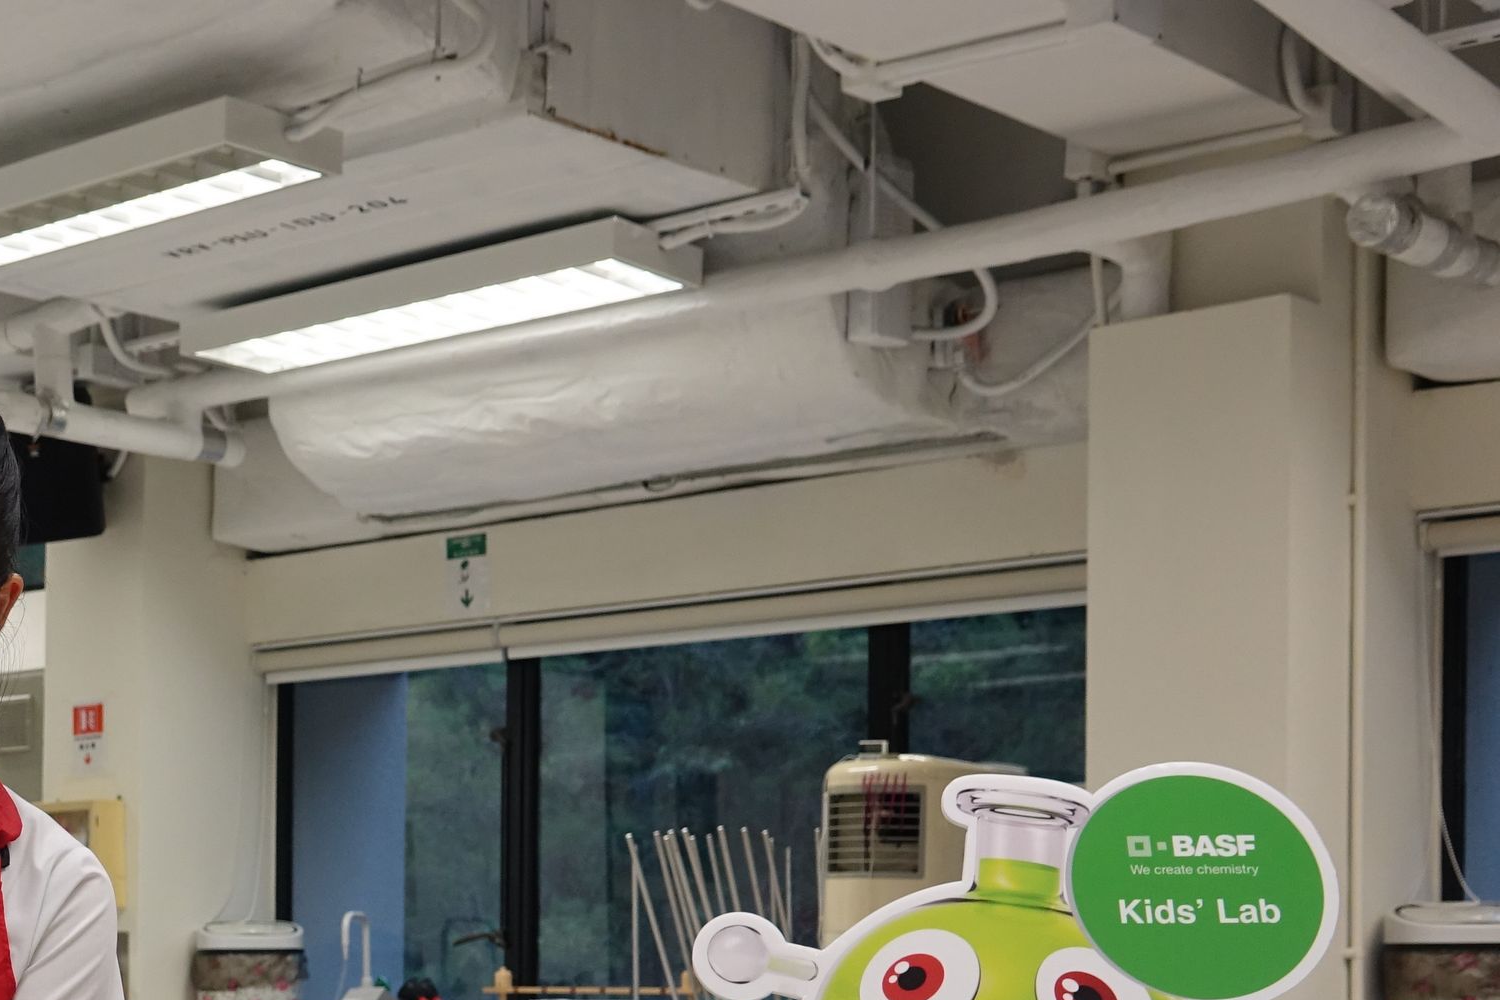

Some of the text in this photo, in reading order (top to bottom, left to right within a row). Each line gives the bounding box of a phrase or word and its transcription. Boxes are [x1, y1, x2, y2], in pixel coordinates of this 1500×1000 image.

[1172, 834, 1255, 857] BASF
[1130, 864, 1259, 876] We create chemistry
[1118, 898, 1281, 925] Kids' Lab
